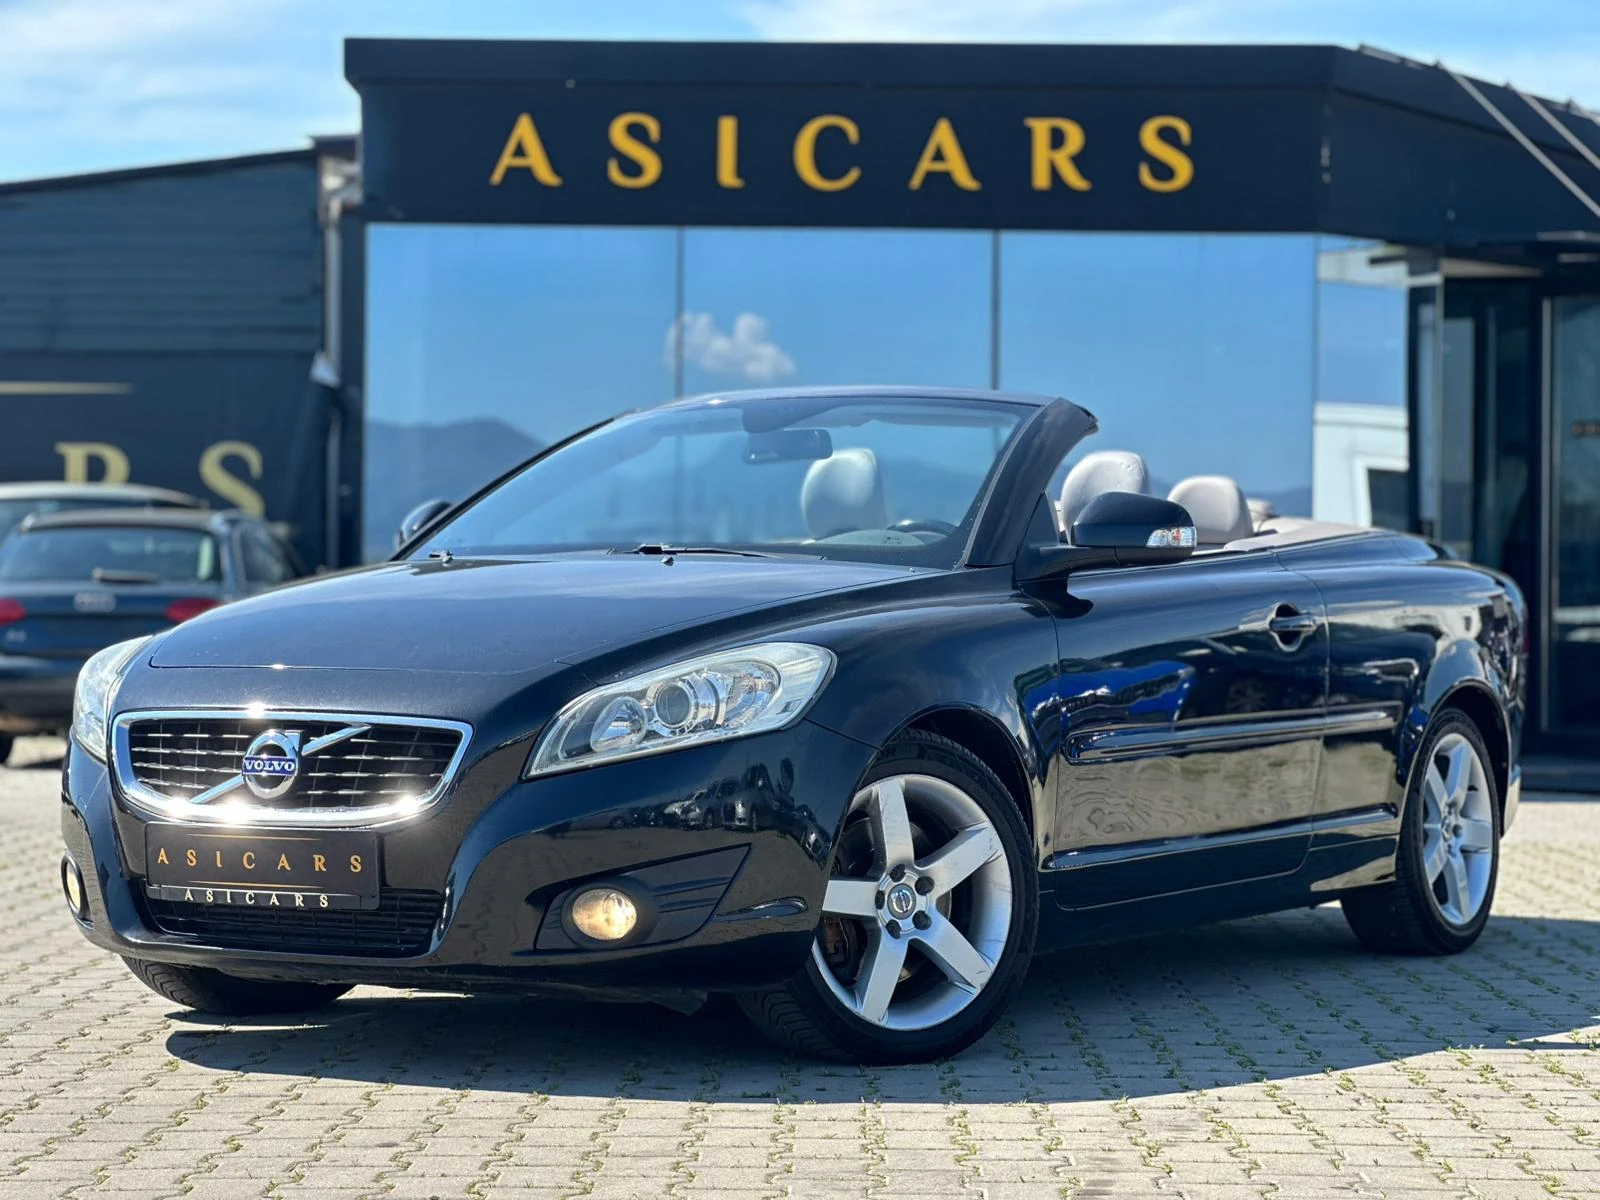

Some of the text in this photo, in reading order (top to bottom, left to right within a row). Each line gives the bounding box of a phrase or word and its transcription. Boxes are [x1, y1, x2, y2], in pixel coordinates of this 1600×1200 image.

[489, 111, 1195, 193] ASICARS
[243, 759, 296, 772] VOLVO
[157, 847, 363, 873] ASICARS
[184, 887, 329, 908] ASICARS
